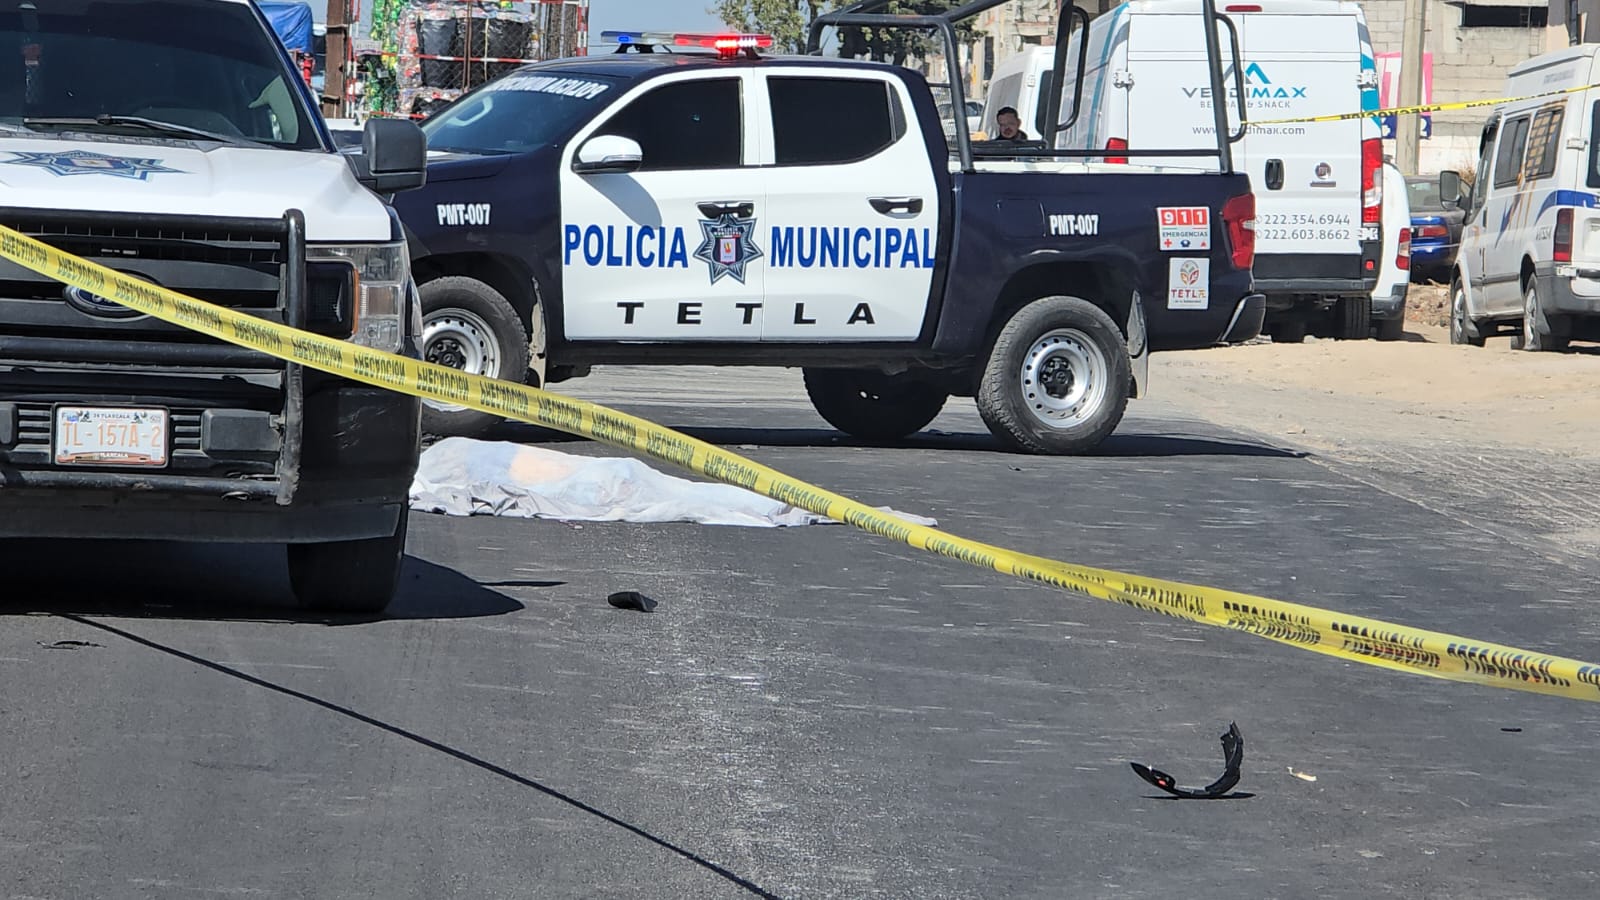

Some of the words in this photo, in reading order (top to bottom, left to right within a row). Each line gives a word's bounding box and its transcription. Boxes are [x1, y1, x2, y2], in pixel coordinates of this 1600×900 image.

[1182, 87, 1306, 98] VEDIMAX
[437, 203, 491, 225] PMT-007
[1163, 210, 1205, 224] 911
[1264, 214, 1350, 225] 222.354.6944
[1049, 214, 1099, 236] PMT-007
[1264, 229, 1350, 240] 222.603.8662
[564, 224, 689, 269] POLICIA
[770, 226, 935, 269] MUNICIPAL
[63, 421, 161, 447] TL-157A-2
